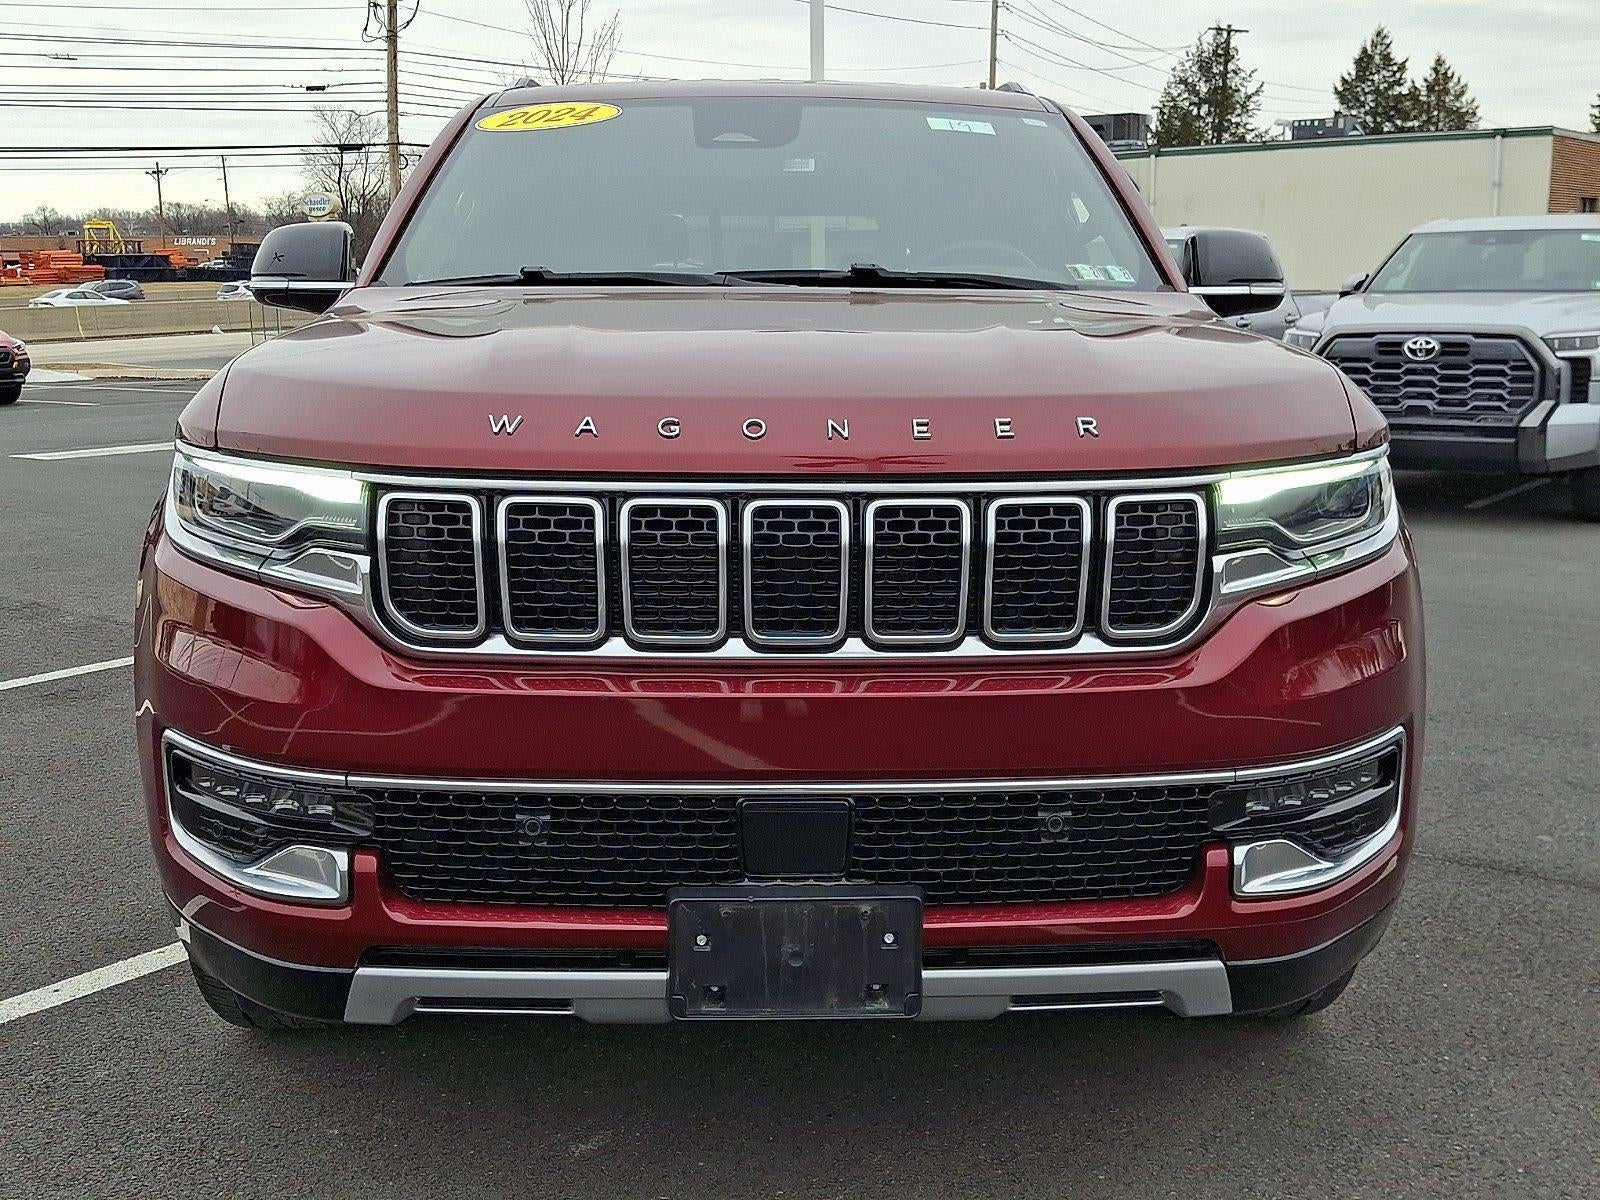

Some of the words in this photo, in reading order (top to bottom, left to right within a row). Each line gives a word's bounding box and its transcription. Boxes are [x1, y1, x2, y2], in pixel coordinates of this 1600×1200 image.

[496, 106, 601, 128] 2024
[173, 237, 217, 246] LIBRANDI'S
[488, 414, 1099, 441] WAGONEER
